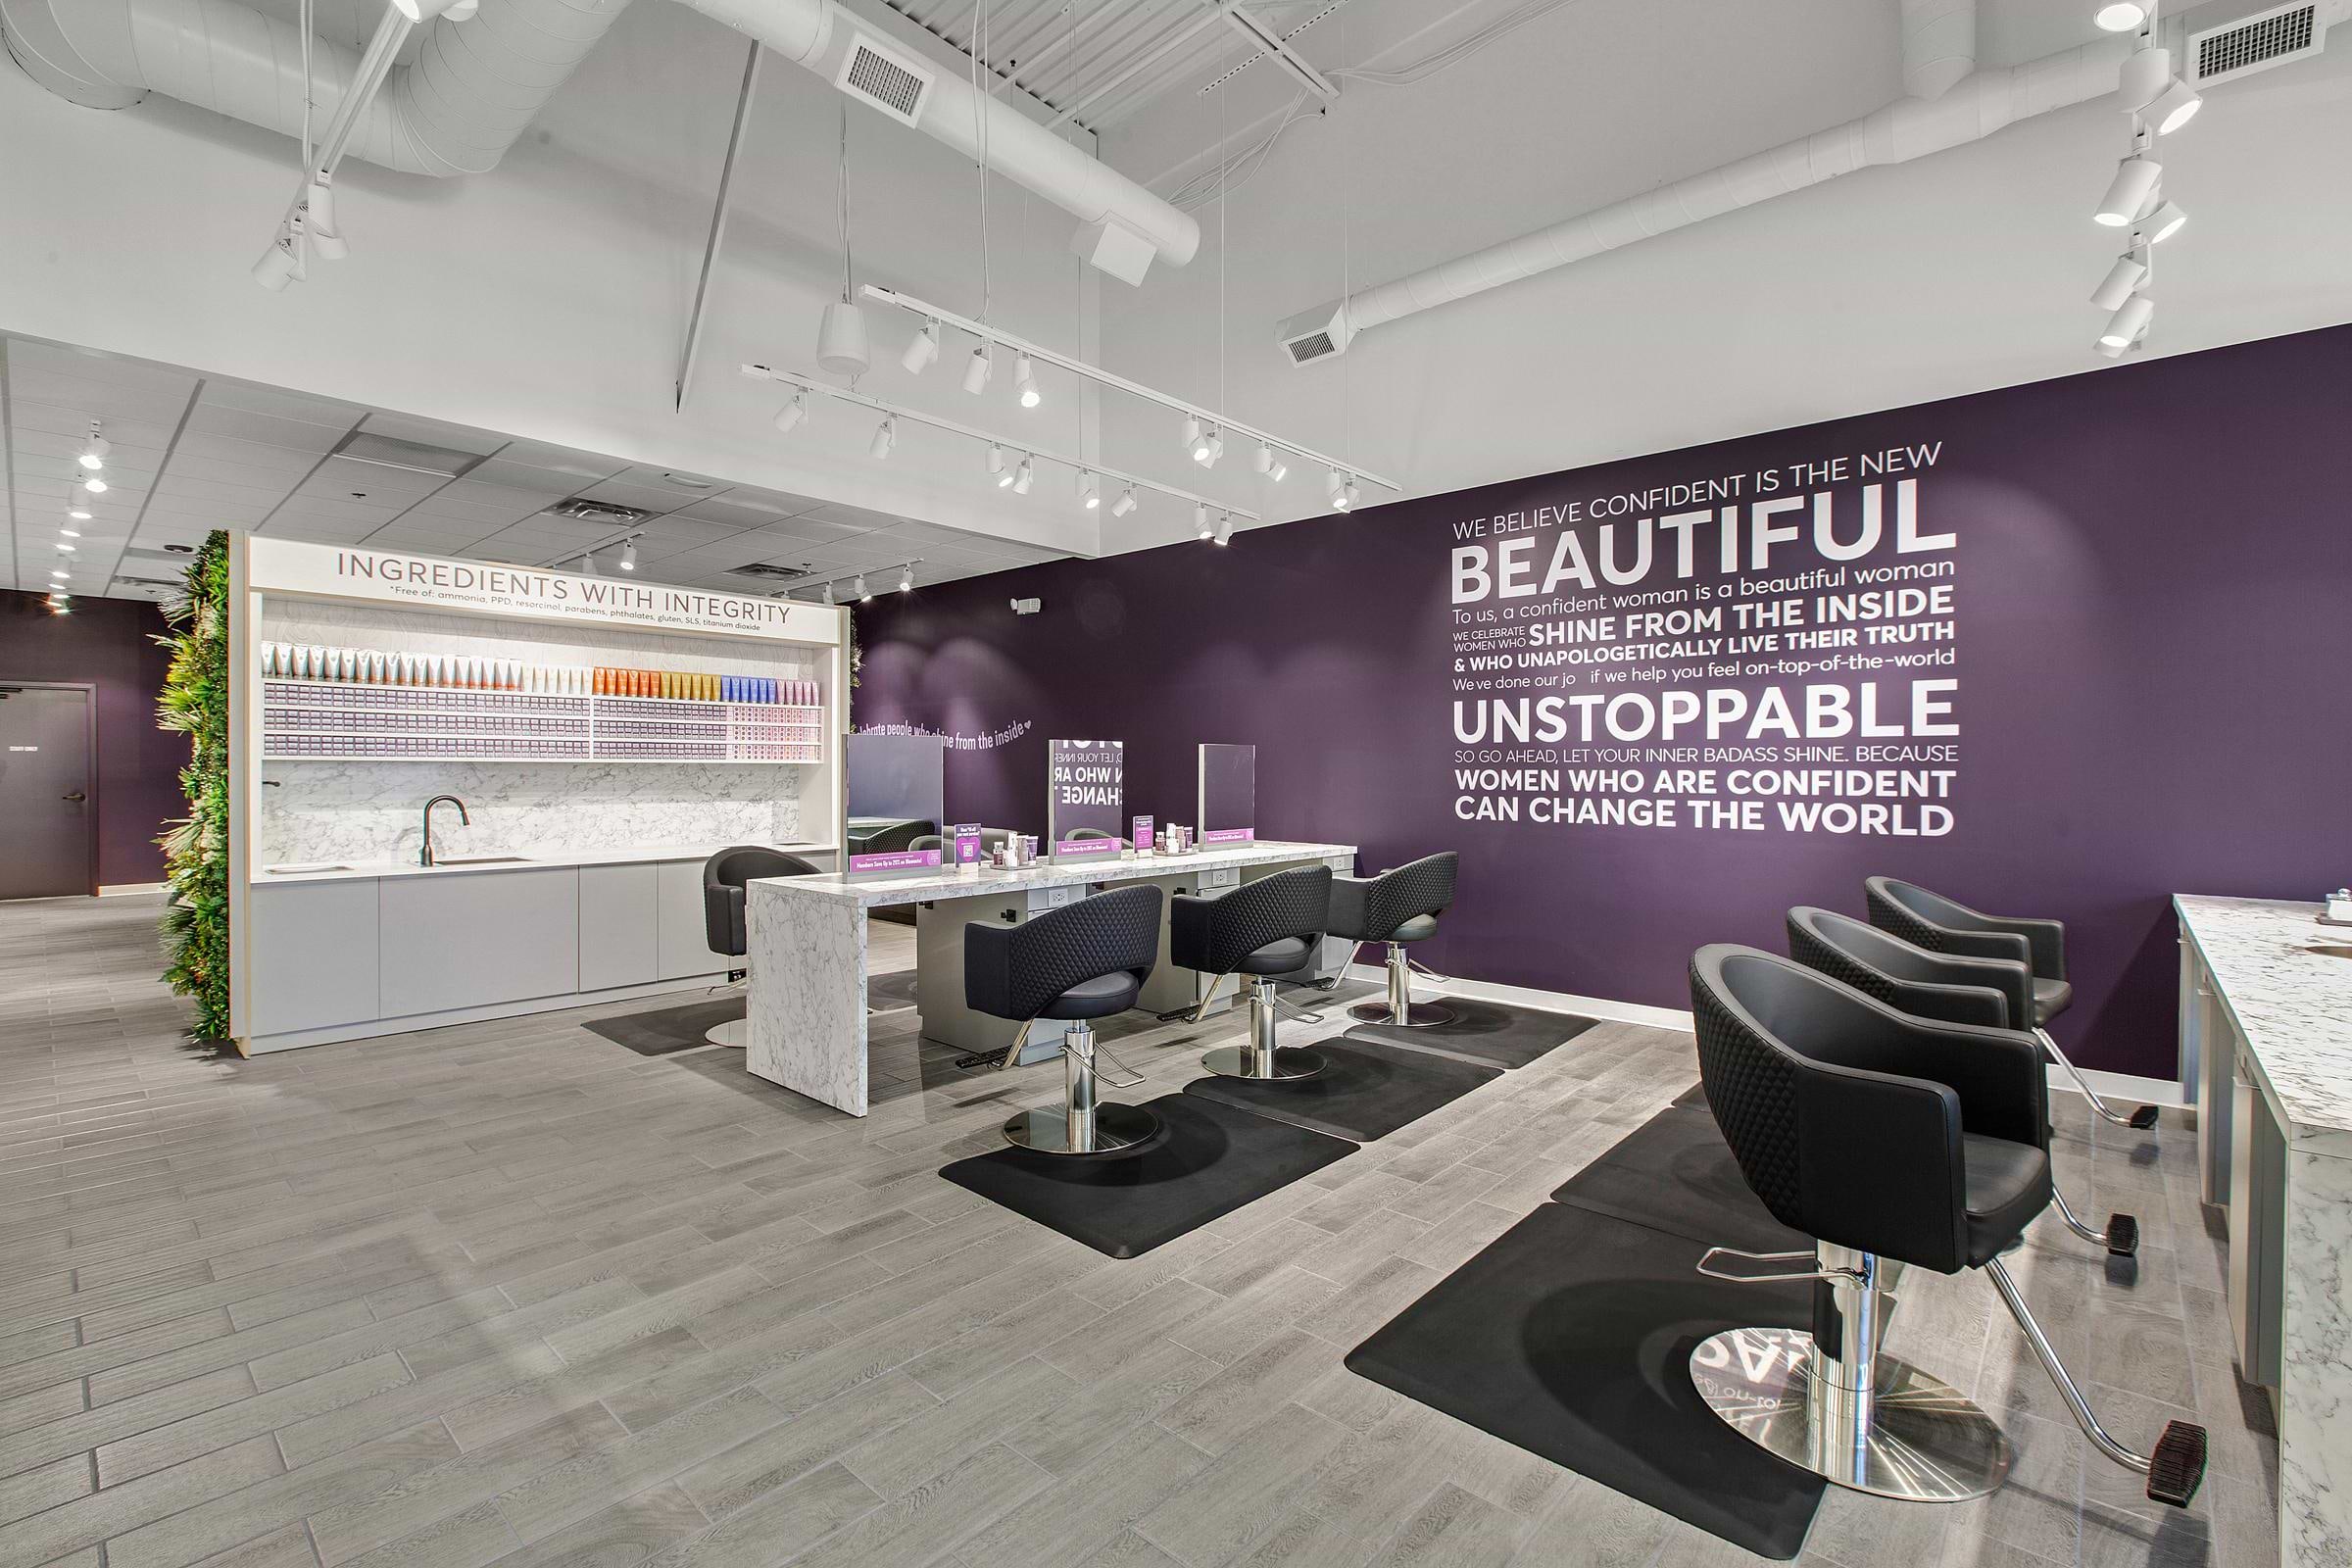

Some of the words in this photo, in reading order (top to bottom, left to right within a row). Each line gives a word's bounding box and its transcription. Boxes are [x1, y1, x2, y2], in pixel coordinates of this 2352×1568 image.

[1453, 518, 1487, 540] WE
[1494, 502, 1582, 535] BELIEVE
[1589, 474, 1747, 518] CONFIDENT
[1756, 469, 1780, 494] IS
[1788, 457, 1850, 487] THE
[1861, 441, 1943, 477] NEW
[1451, 478, 1957, 605] BEAUTIFUL
[339, 553, 567, 600] INGREDIENTS
[581, 582, 653, 610] WITH
[665, 592, 791, 624] INTEGRITY
[1452, 609, 1471, 625] To
[1477, 609, 1497, 623] us,
[1503, 607, 1514, 619] a
[1520, 594, 1607, 618] confident
[1612, 588, 1689, 610] woman
[1695, 582, 1712, 601] is
[1718, 583, 1733, 599] a
[1740, 566, 1846, 597] beautiful
[1854, 561, 1955, 585] woman
[438, 592, 488, 604] ammonia,
[491, 596, 513, 607] PPD,
[685, 616, 701, 626] SLS,
[703, 618, 734, 629] titanium
[735, 622, 760, 631] dioxide
[1529, 616, 1616, 647] SHINE
[1626, 607, 1722, 639] FROM
[1733, 599, 1805, 630] THE
[1817, 584, 1955, 623] INSIDE
[1453, 631, 1469, 641] WE
[1471, 626, 1526, 640] CELEBRATE
[1453, 640, 1495, 653] WOMEN
[1498, 637, 1527, 649] WHO
[1454, 658, 1466, 672] &
[1469, 655, 1513, 671] WHO
[1517, 638, 1723, 668] UNAPOLOGETICALLY
[1729, 634, 1779, 655] LIVE
[1785, 628, 1858, 650] THEIR
[1864, 620, 1955, 646] TRUTH
[1495, 675, 1531, 690] done
[1535, 675, 1558, 687] our
[1591, 668, 1600, 684] if
[1604, 670, 1627, 682] we
[1632, 665, 1667, 684] help
[1671, 667, 1702, 682] you
[1707, 661, 1740, 678] feel
[1745, 647, 1956, 676] on-top-of-the-world
[1453, 678, 1960, 744] UNSTOPPABLE
[956, 732, 976, 750] from
[978, 730, 993, 750] the
[995, 719, 1025, 747] inside
[1454, 749, 1475, 763] SO
[1479, 749, 1501, 763] GO
[1505, 749, 1558, 764] AHEAD,
[1563, 748, 1591, 762] LET
[1593, 748, 1641, 763] YOUR
[1646, 747, 1699, 762] INNER
[1704, 747, 1779, 762] BADASS
[1784, 746, 1849, 762] SHINE.
[1856, 745, 1960, 762] BECAUSE
[1453, 768, 1560, 791] WOMEN
[1568, 768, 1645, 793] WHO
[1652, 769, 1718, 795] ARE
[1727, 769, 1957, 798] CONFIDENT
[1454, 796, 1519, 822] CAN
[1529, 797, 1677, 827] CHANGE
[1688, 800, 1764, 830] THE
[1776, 802, 1955, 837] WORLD
